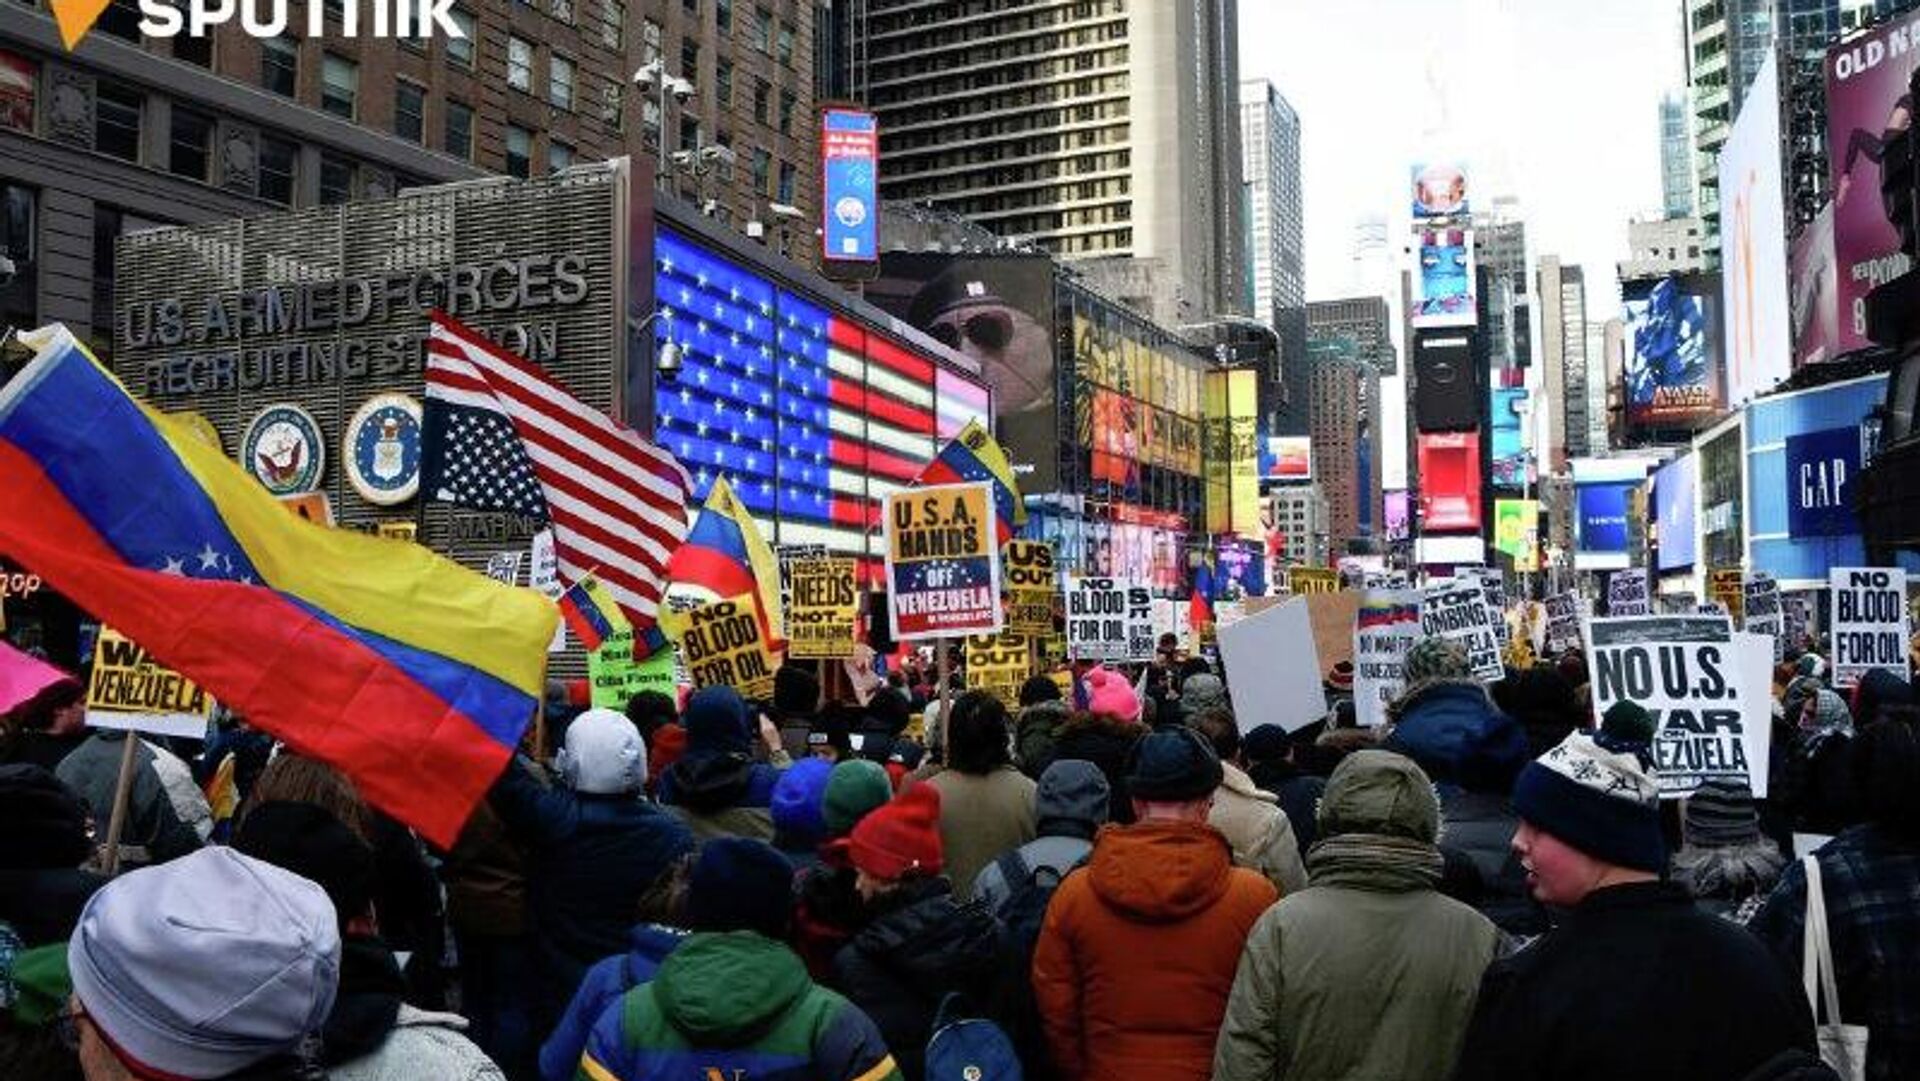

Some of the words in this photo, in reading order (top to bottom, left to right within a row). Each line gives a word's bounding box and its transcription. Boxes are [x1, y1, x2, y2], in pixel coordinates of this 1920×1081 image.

[1836, 40, 1885, 80] OLD
[125, 298, 194, 348] U.S.
[200, 279, 371, 338] ARMED
[381, 254, 589, 322] FORCES
[146, 338, 368, 395] RECRUITING
[1801, 458, 1846, 508] GAP
[895, 497, 977, 529] U.S.A.
[900, 527, 979, 558] HANDS
[1010, 542, 1052, 568] US
[793, 574, 854, 606] NEEDS
[927, 568, 953, 588] OFF
[1010, 568, 1052, 586] OUT
[1080, 579, 1113, 589] NO
[1850, 572, 1889, 587] NO
[690, 601, 736, 625] NO
[896, 586, 991, 615] VENEZUELA
[1070, 591, 1124, 616] BLOOD
[1425, 589, 1480, 609] TOP
[1838, 589, 1900, 623] BLOOD
[793, 611, 837, 623] NOT
[1070, 620, 1099, 641] FOR
[1103, 620, 1125, 641] OIL
[1423, 603, 1488, 636] OMBING
[684, 614, 758, 662] BLOOD
[1837, 632, 1875, 664] FOR
[1877, 632, 1904, 664] OIL
[692, 659, 737, 688] FOR
[735, 649, 772, 680] OIL
[969, 650, 1027, 667] OUT
[1596, 646, 1654, 701] NO
[1658, 646, 1736, 700] U.S.
[93, 668, 204, 713] VENEZUELA
[1649, 708, 1744, 734] AR
[1653, 738, 1749, 771] EZUELA
